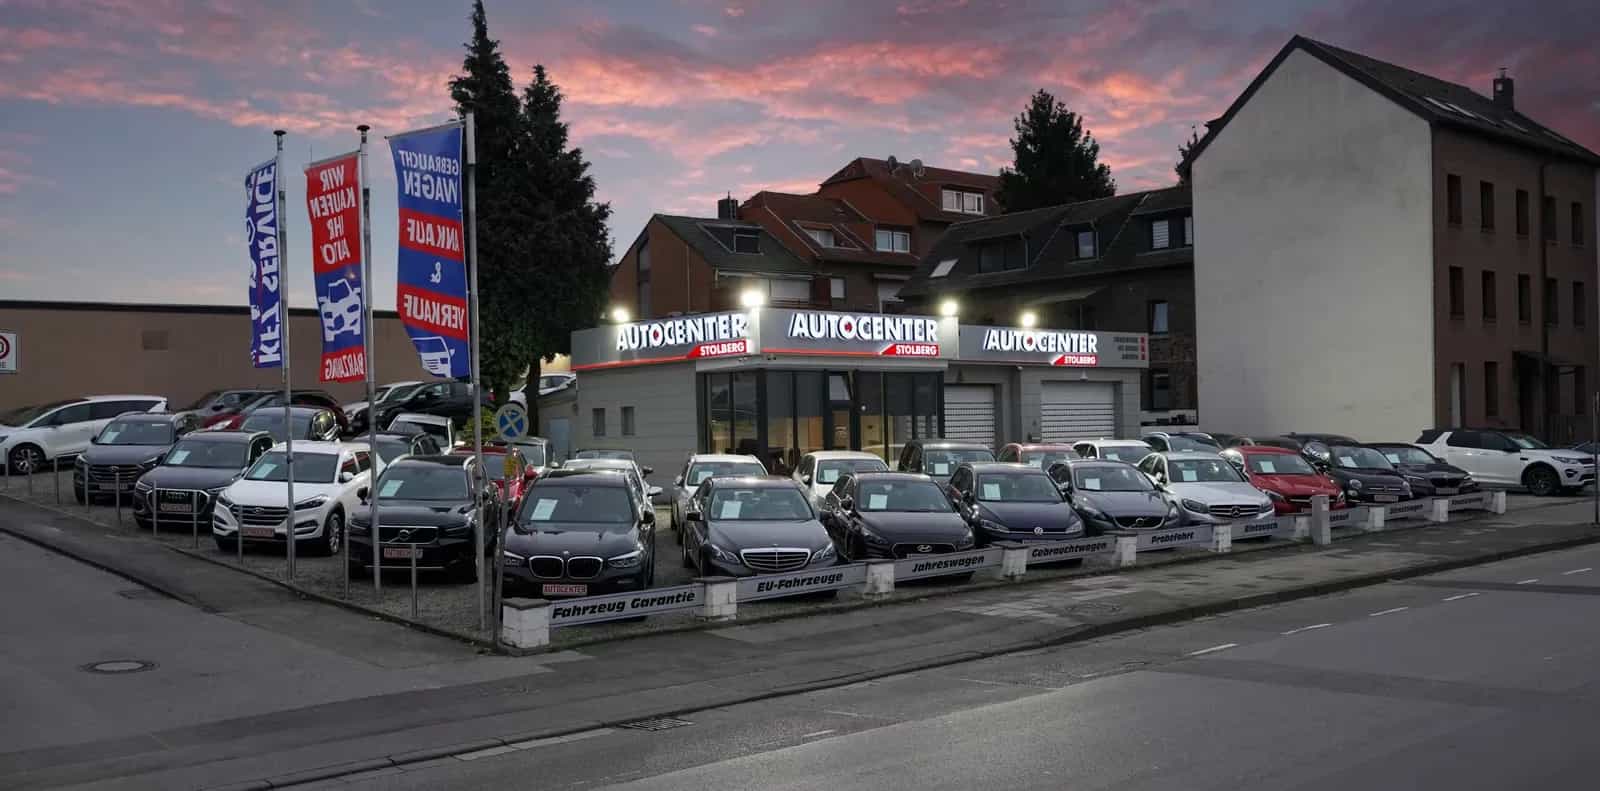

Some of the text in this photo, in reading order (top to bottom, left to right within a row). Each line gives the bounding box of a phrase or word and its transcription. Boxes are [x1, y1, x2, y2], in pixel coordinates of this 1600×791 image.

[616, 312, 748, 351] AUTOCENTER
[787, 312, 939, 342] AUTOCENTER
[700, 341, 745, 357] STOLBERG
[895, 343, 937, 356] STOLBERG
[983, 329, 1098, 353] AUTOCENTER
[1063, 354, 1096, 365] STOLBERG
[1031, 541, 1108, 558] Gebrauchtwagen
[912, 554, 985, 573] Jahreswagen
[543, 584, 587, 594] AUTOCENTER
[756, 571, 844, 593] EU-Fahrzeuge
[552, 590, 696, 620] Fahrzeug Garantie
